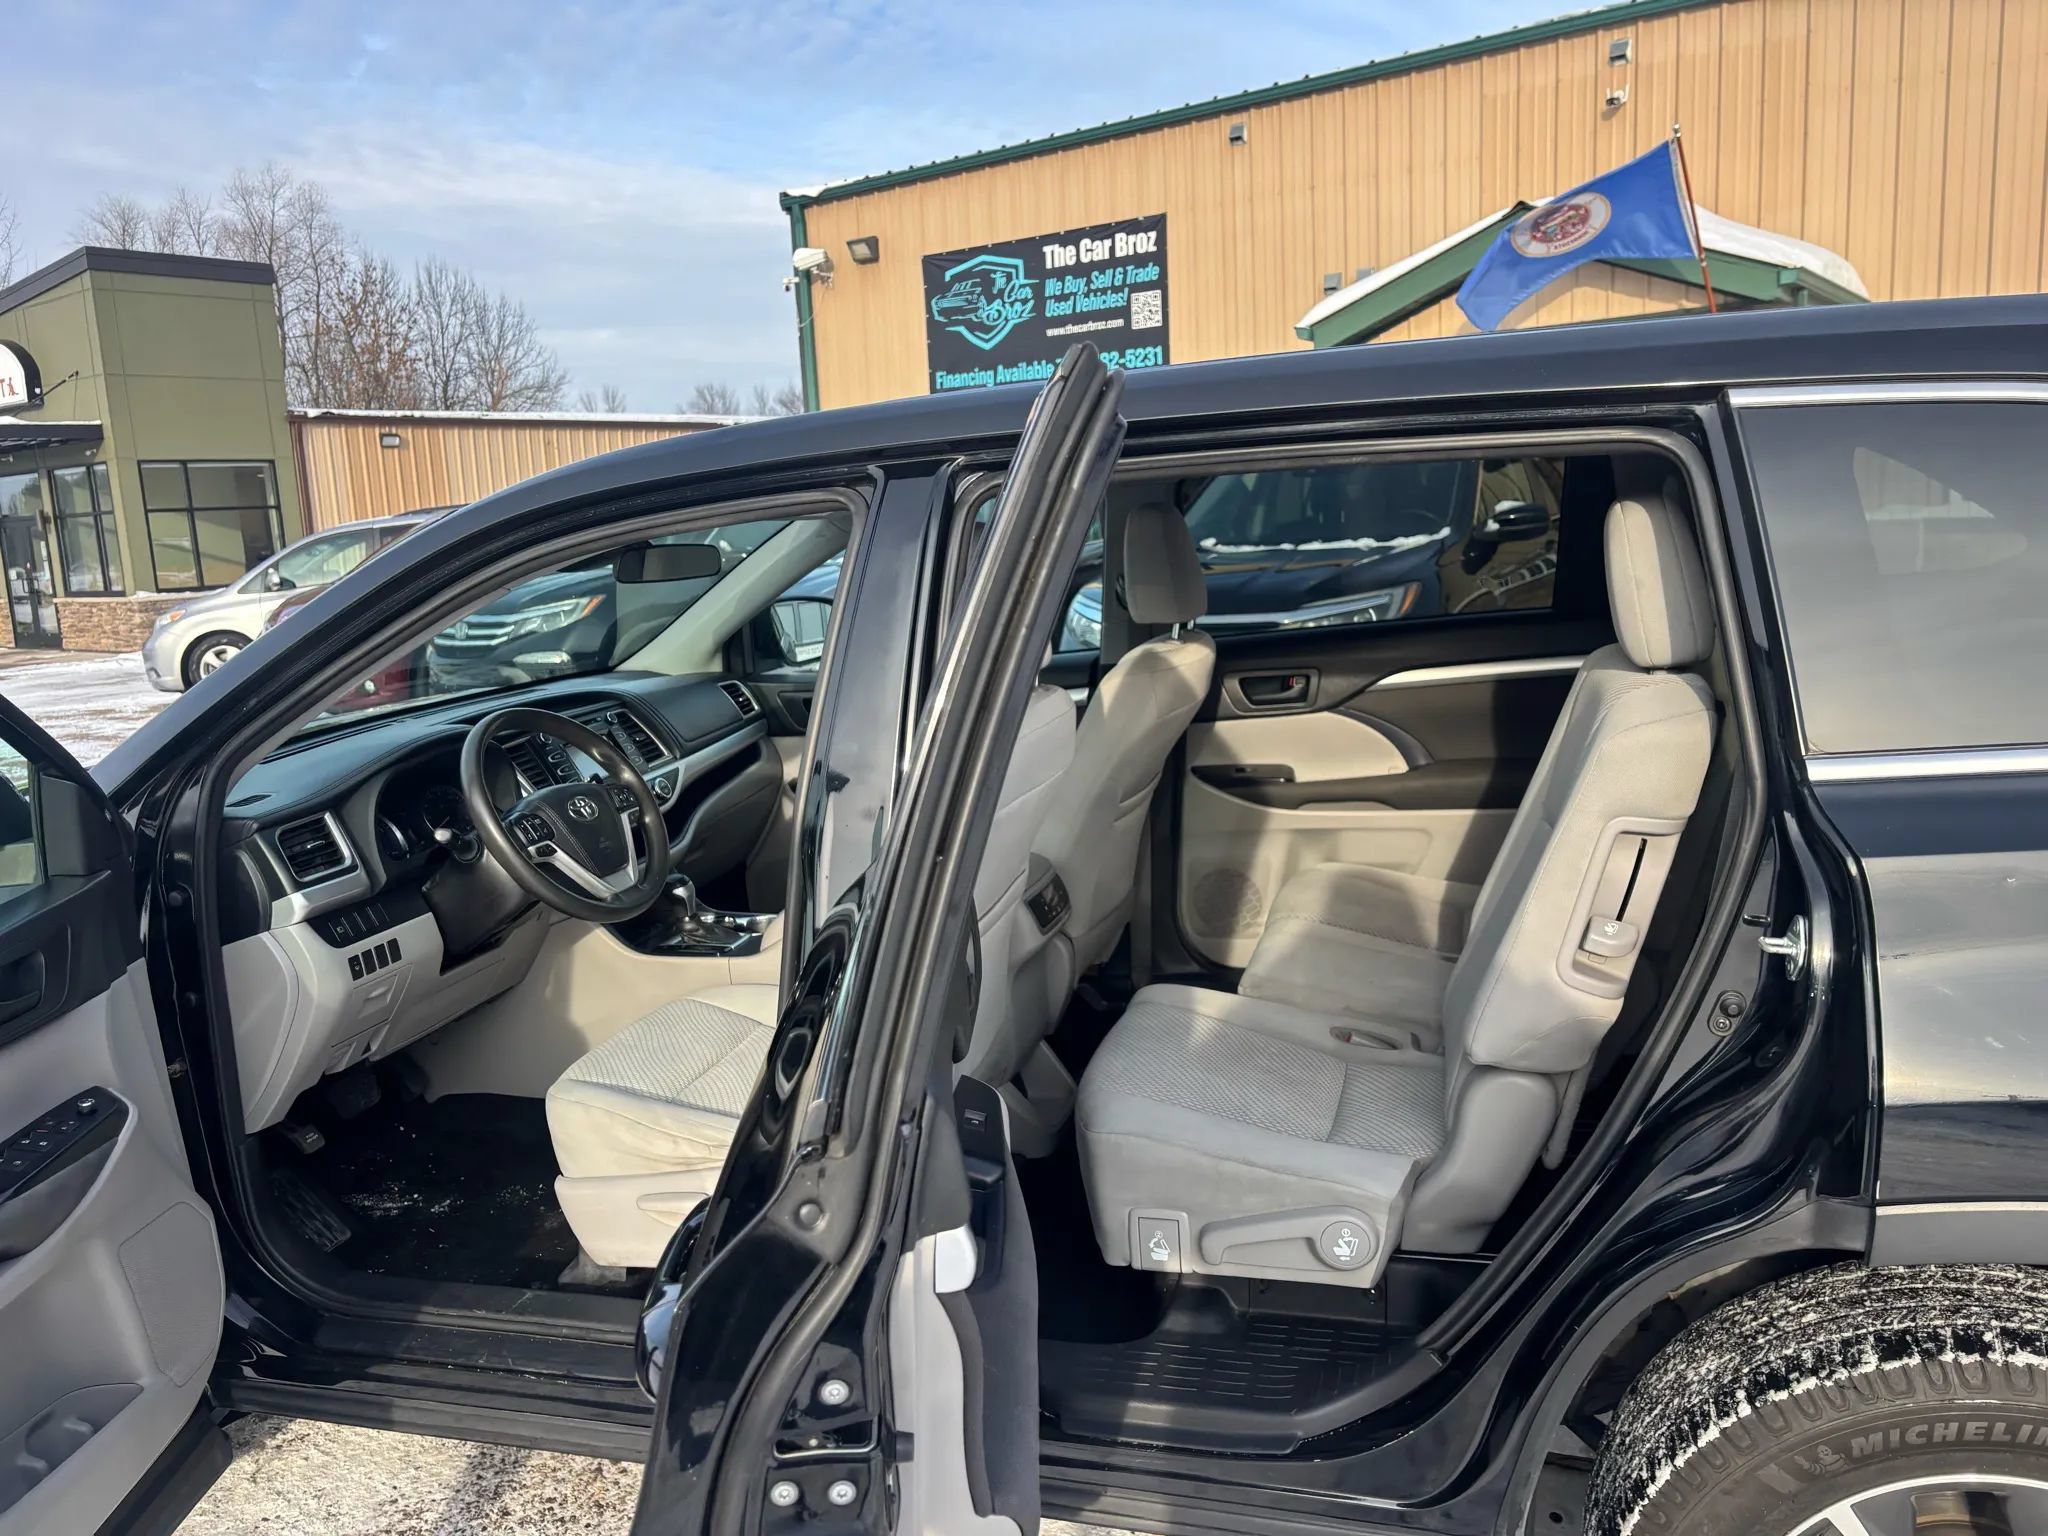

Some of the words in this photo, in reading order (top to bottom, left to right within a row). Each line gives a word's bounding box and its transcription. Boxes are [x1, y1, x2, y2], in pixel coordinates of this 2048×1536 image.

[1042, 243, 1077, 269] The
[1079, 238, 1112, 263] Car
[1114, 230, 1158, 258] Broz
[1004, 280, 1033, 302] Car
[1044, 277, 1063, 297] We
[1063, 275, 1088, 295] Buy,
[1090, 268, 1114, 290] Sell
[1113, 267, 1124, 287] &
[1125, 262, 1160, 285] Trade
[1044, 295, 1075, 318] Used
[1075, 287, 1129, 313] Vehicles!
[935, 367, 995, 390] Financing
[996, 359, 1055, 384] Available
[1099, 345, 1163, 371] 92-5231
